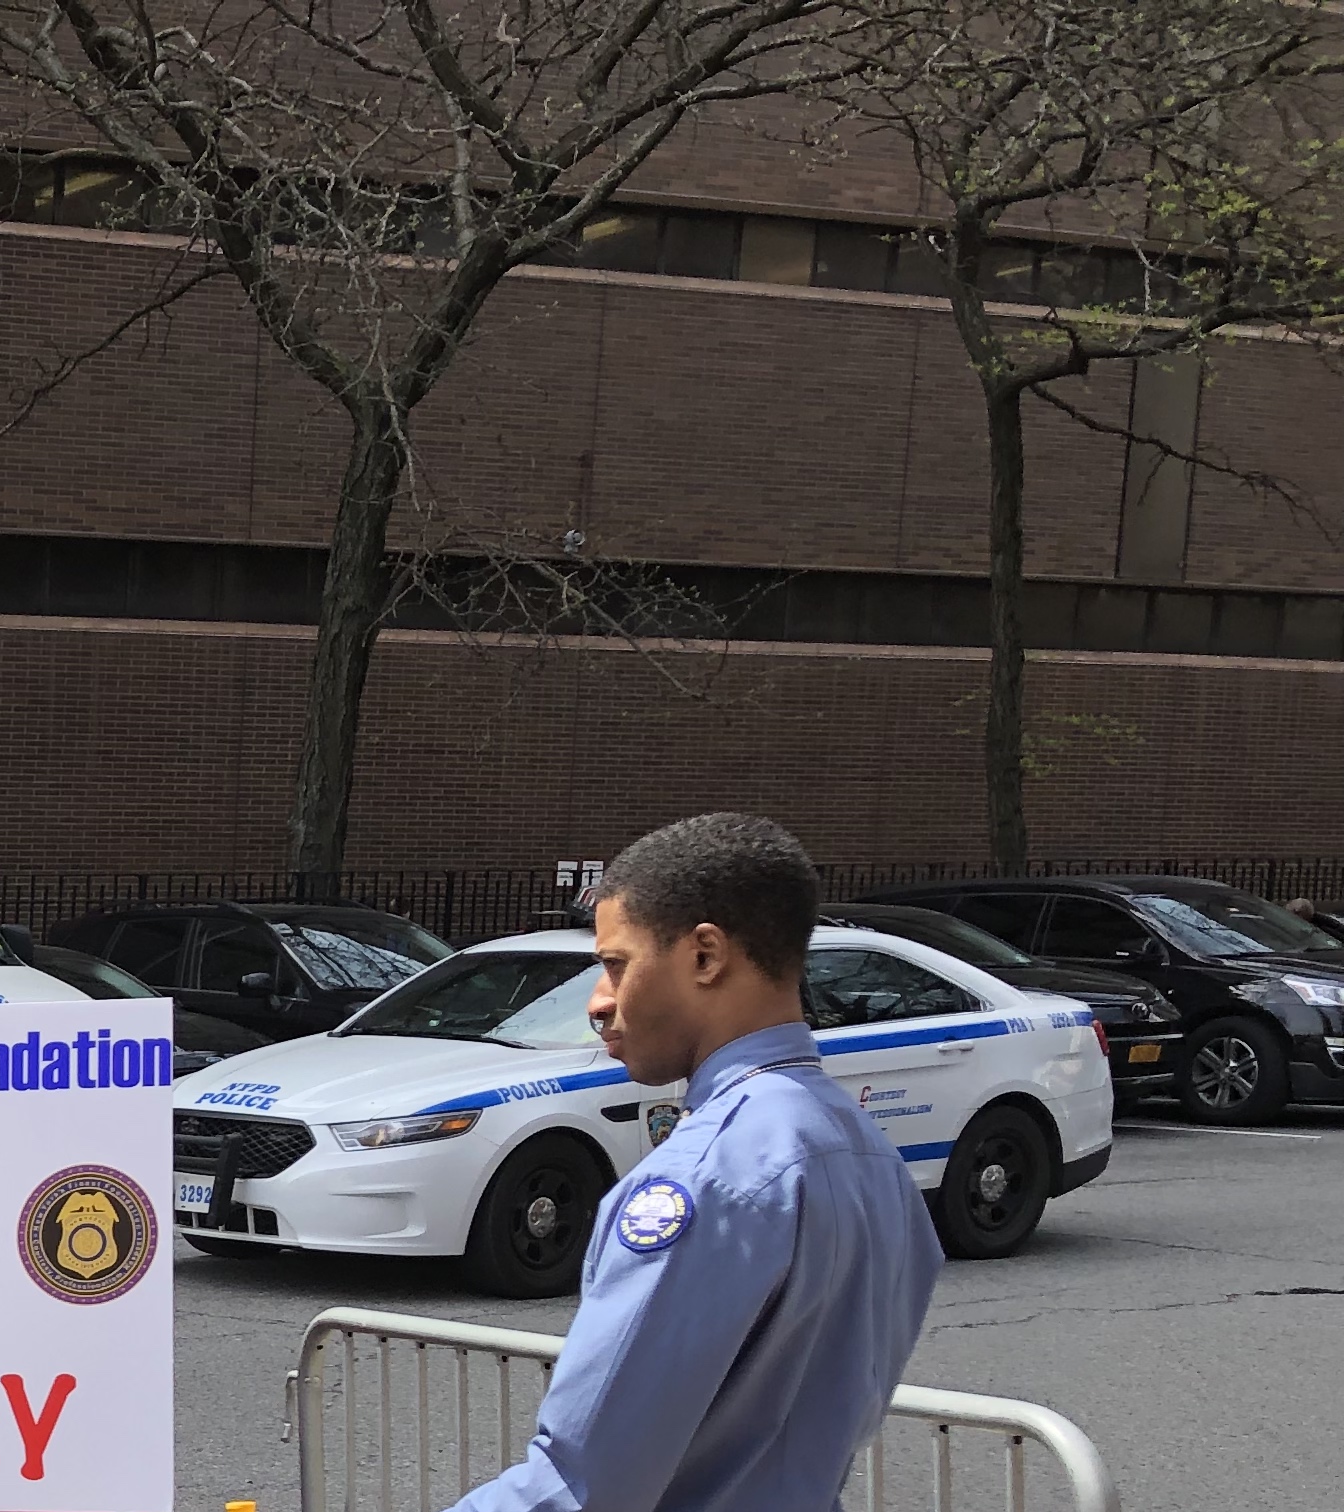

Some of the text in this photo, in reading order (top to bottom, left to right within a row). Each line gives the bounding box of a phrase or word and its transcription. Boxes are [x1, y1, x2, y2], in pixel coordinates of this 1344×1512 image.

[221, 1082, 282, 1095] NYPD
[497, 1078, 563, 1104] POLICE
[194, 1092, 280, 1111] POLICE
[68, 1180, 102, 1190] Finest
